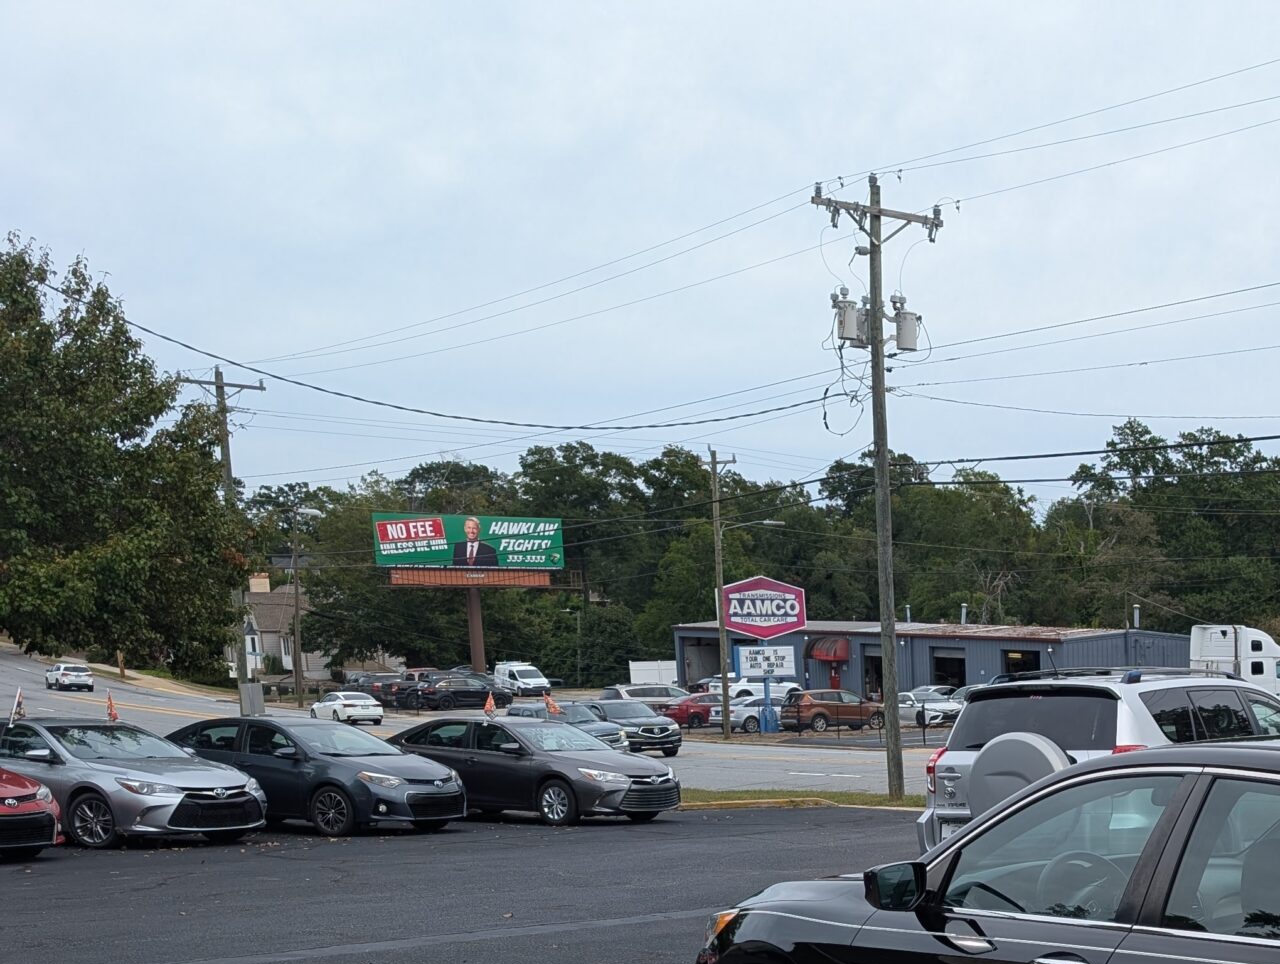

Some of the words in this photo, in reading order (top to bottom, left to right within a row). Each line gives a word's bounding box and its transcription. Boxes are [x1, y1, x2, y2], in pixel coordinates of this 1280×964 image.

[386, 523, 407, 539] NO
[409, 521, 435, 538] FEE
[489, 522, 559, 536] HAWKLAW
[380, 542, 415, 555] UNLESS
[415, 540, 430, 552] WE
[430, 539, 448, 551] WIN
[506, 555, 546, 563] 333-3333
[728, 599, 800, 616] AAMCO
